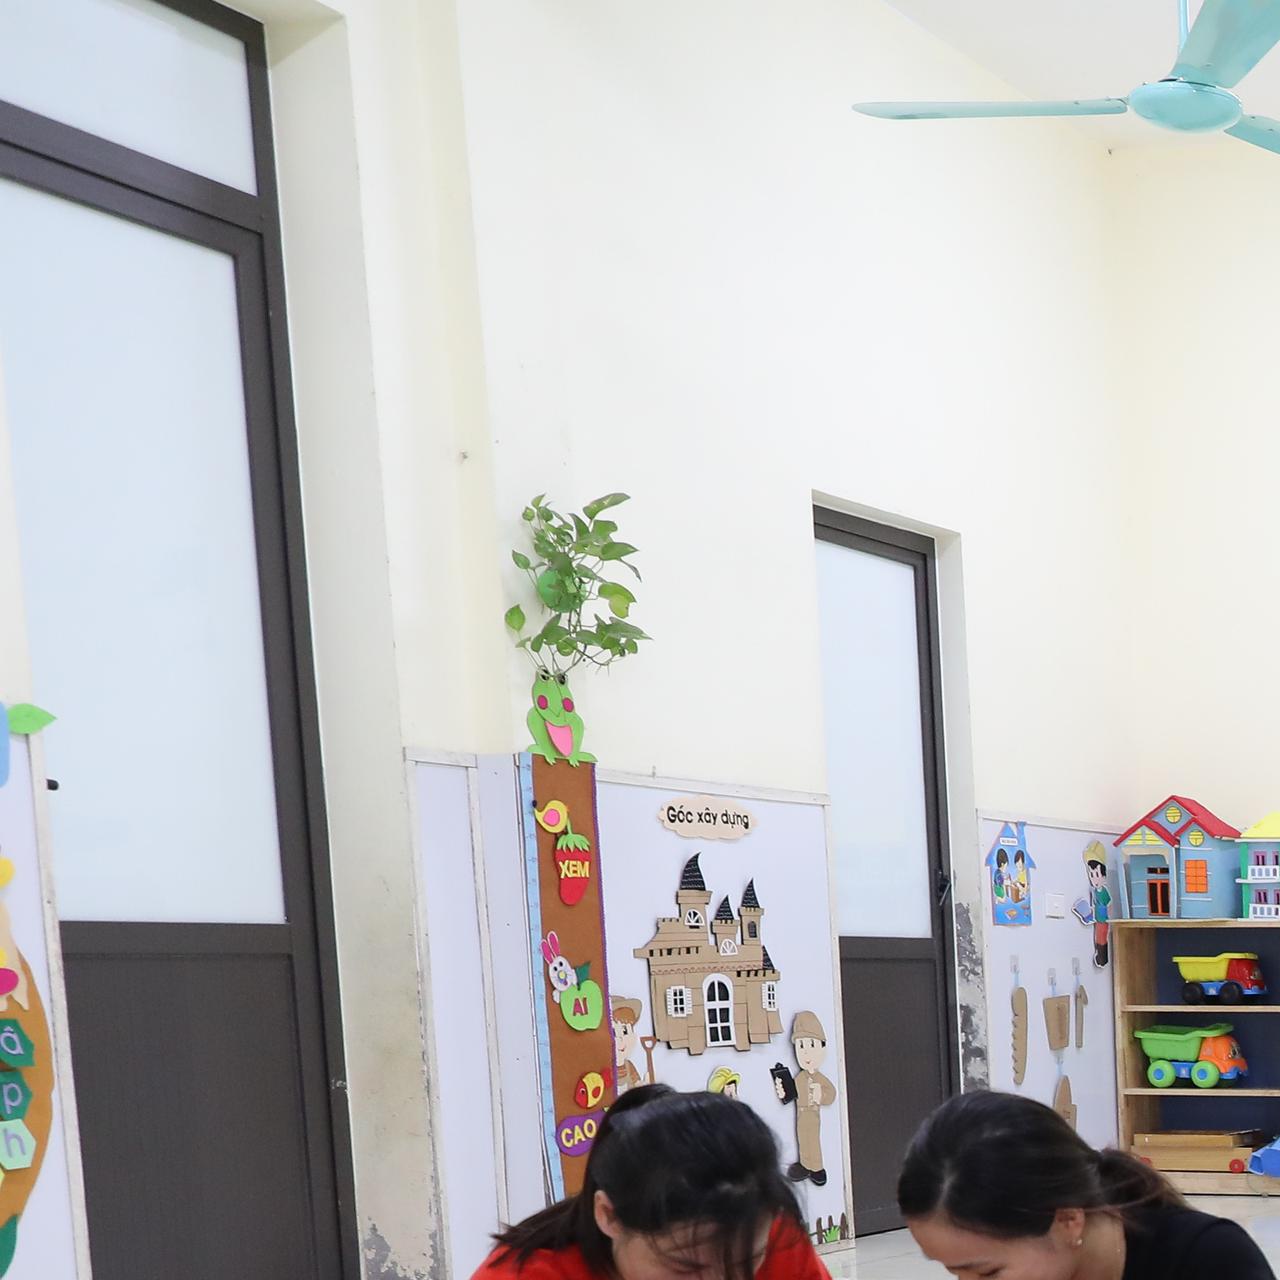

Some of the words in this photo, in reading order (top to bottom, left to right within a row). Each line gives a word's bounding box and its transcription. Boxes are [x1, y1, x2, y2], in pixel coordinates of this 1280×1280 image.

[666, 805, 694, 823] Góc
[697, 807, 718, 825] xây
[721, 809, 750, 829] dựng
[559, 860, 590, 879] XEM
[3, 1082, 22, 1115] p
[3, 1127, 27, 1159] h
[561, 1118, 597, 1148] CAO
